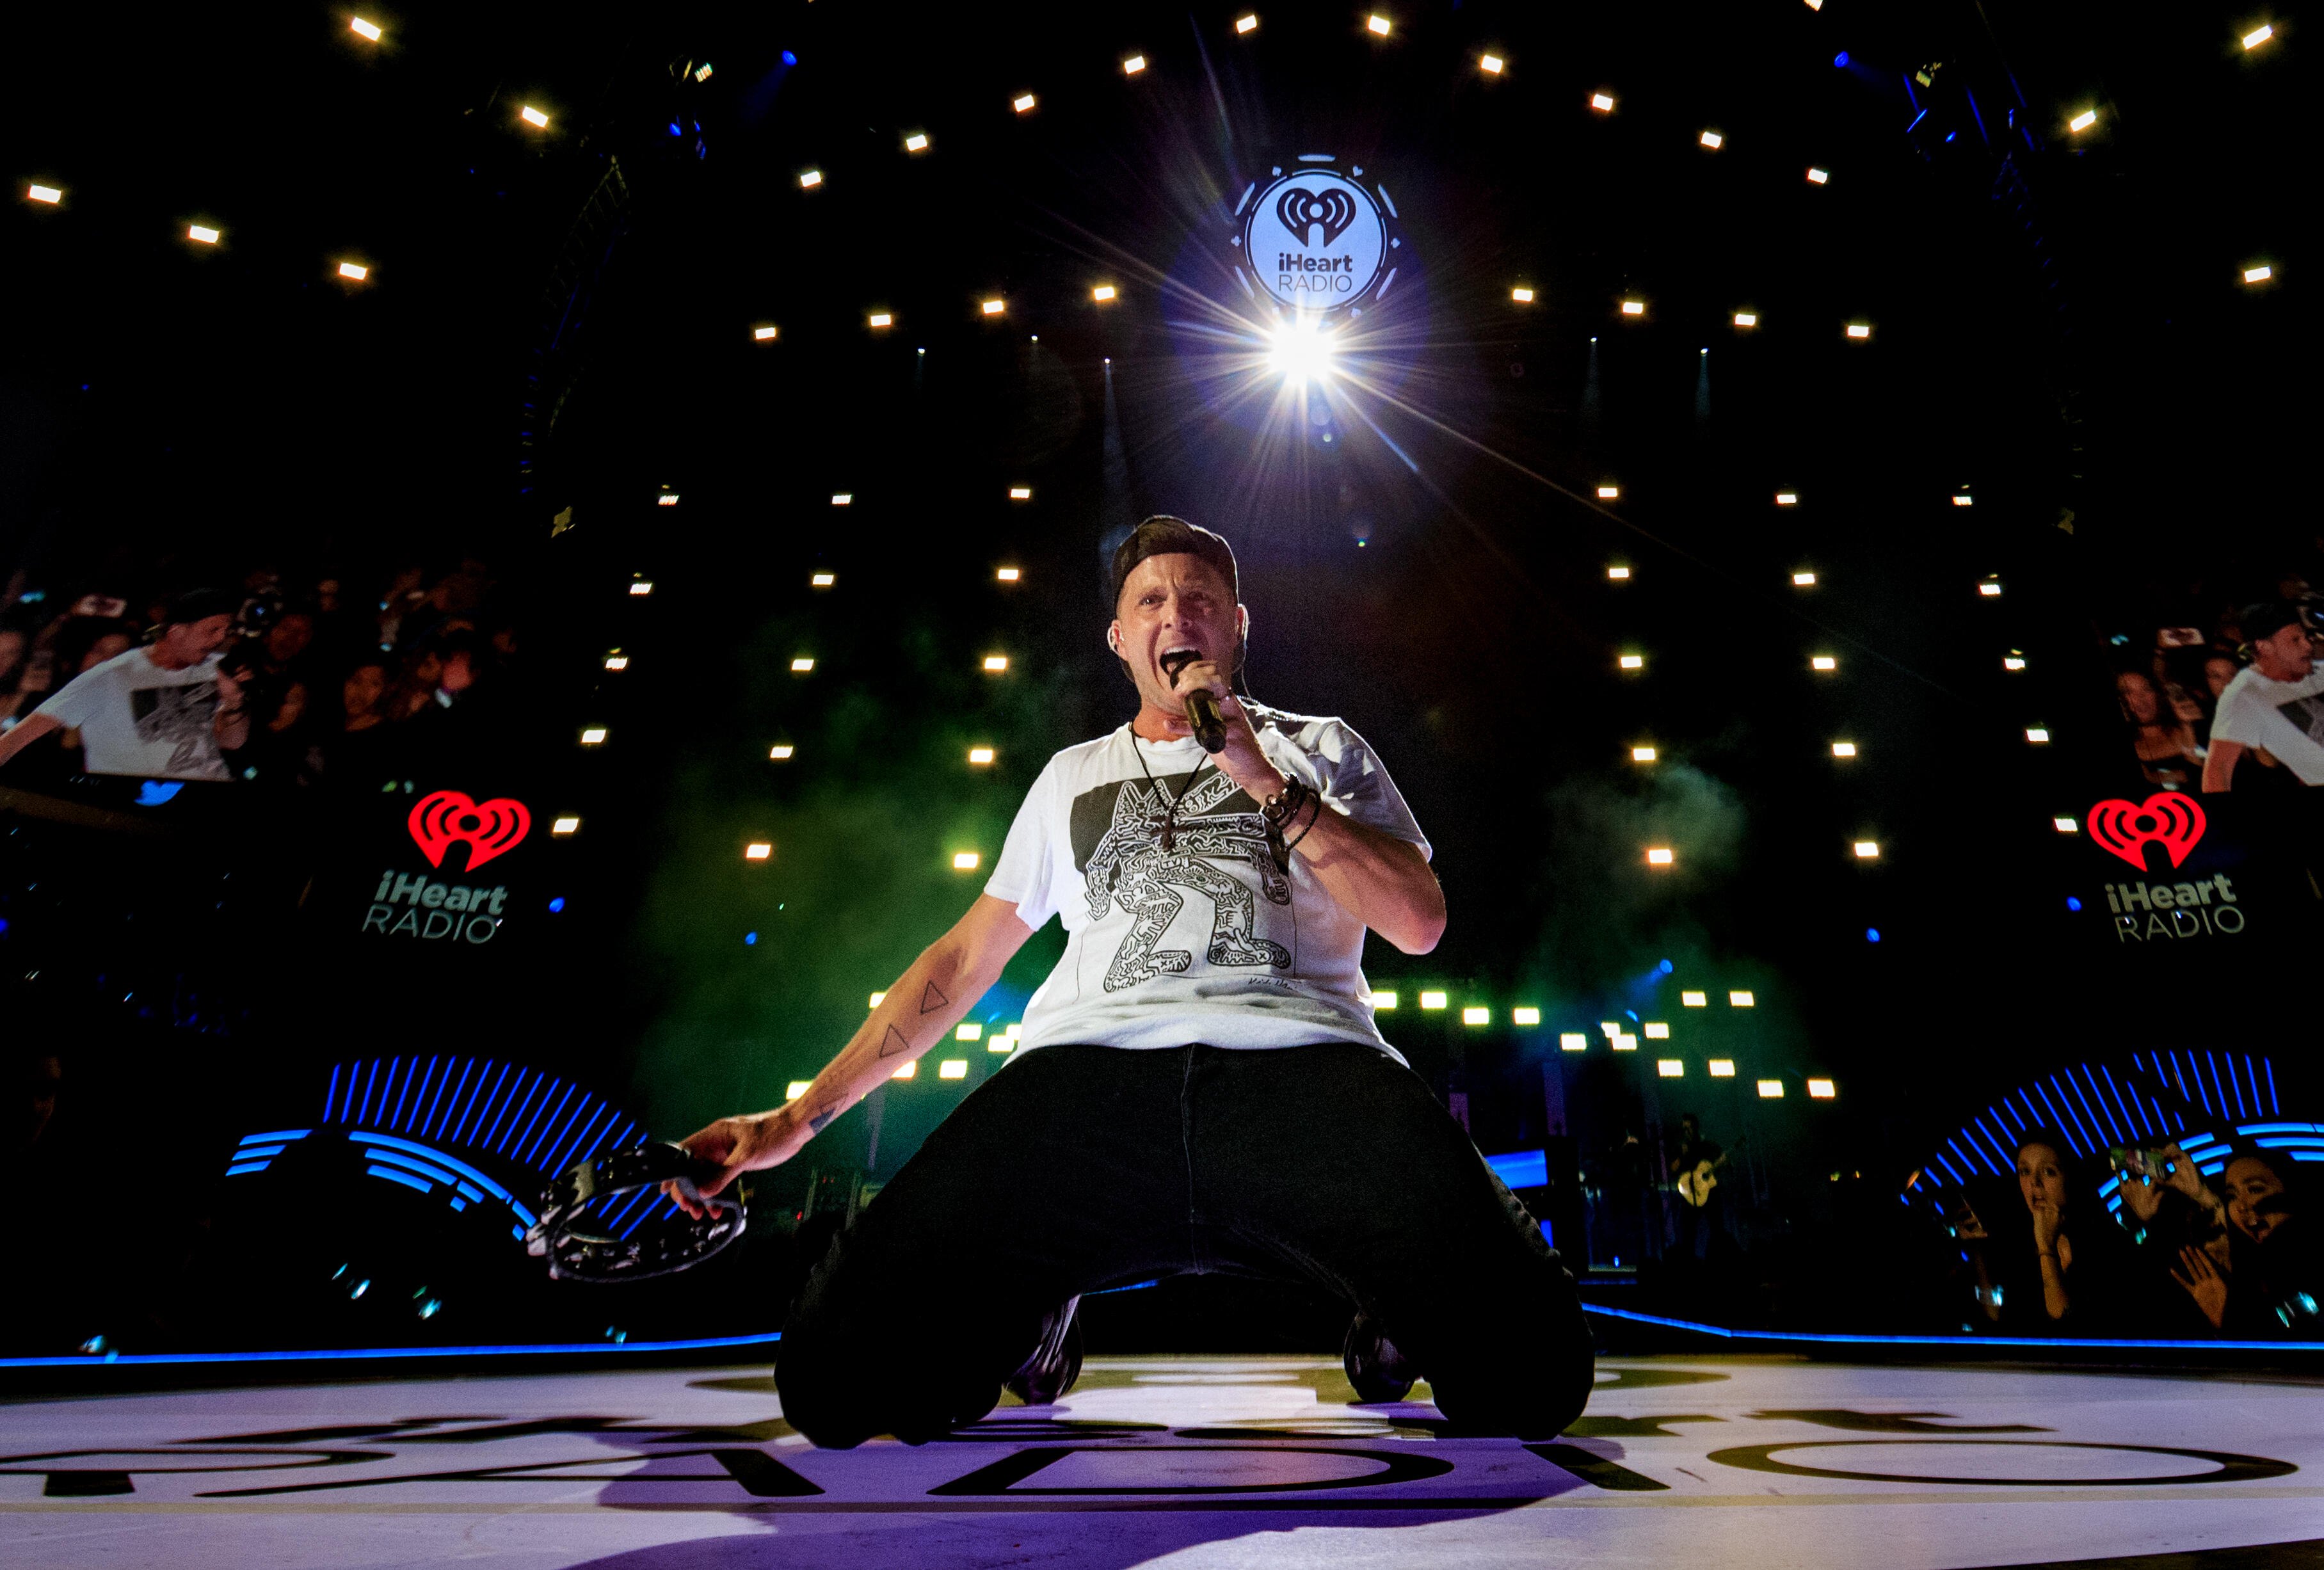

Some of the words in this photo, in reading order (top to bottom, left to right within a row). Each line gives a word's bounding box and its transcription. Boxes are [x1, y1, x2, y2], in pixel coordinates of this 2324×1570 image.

[1279, 253, 1352, 272] iHeart
[1279, 275, 1352, 292] RADIO
[374, 869, 508, 915] iHeart
[2104, 872, 2237, 913] iHeart
[362, 903, 497, 944] RADIO
[2114, 905, 2245, 943] RADIO
